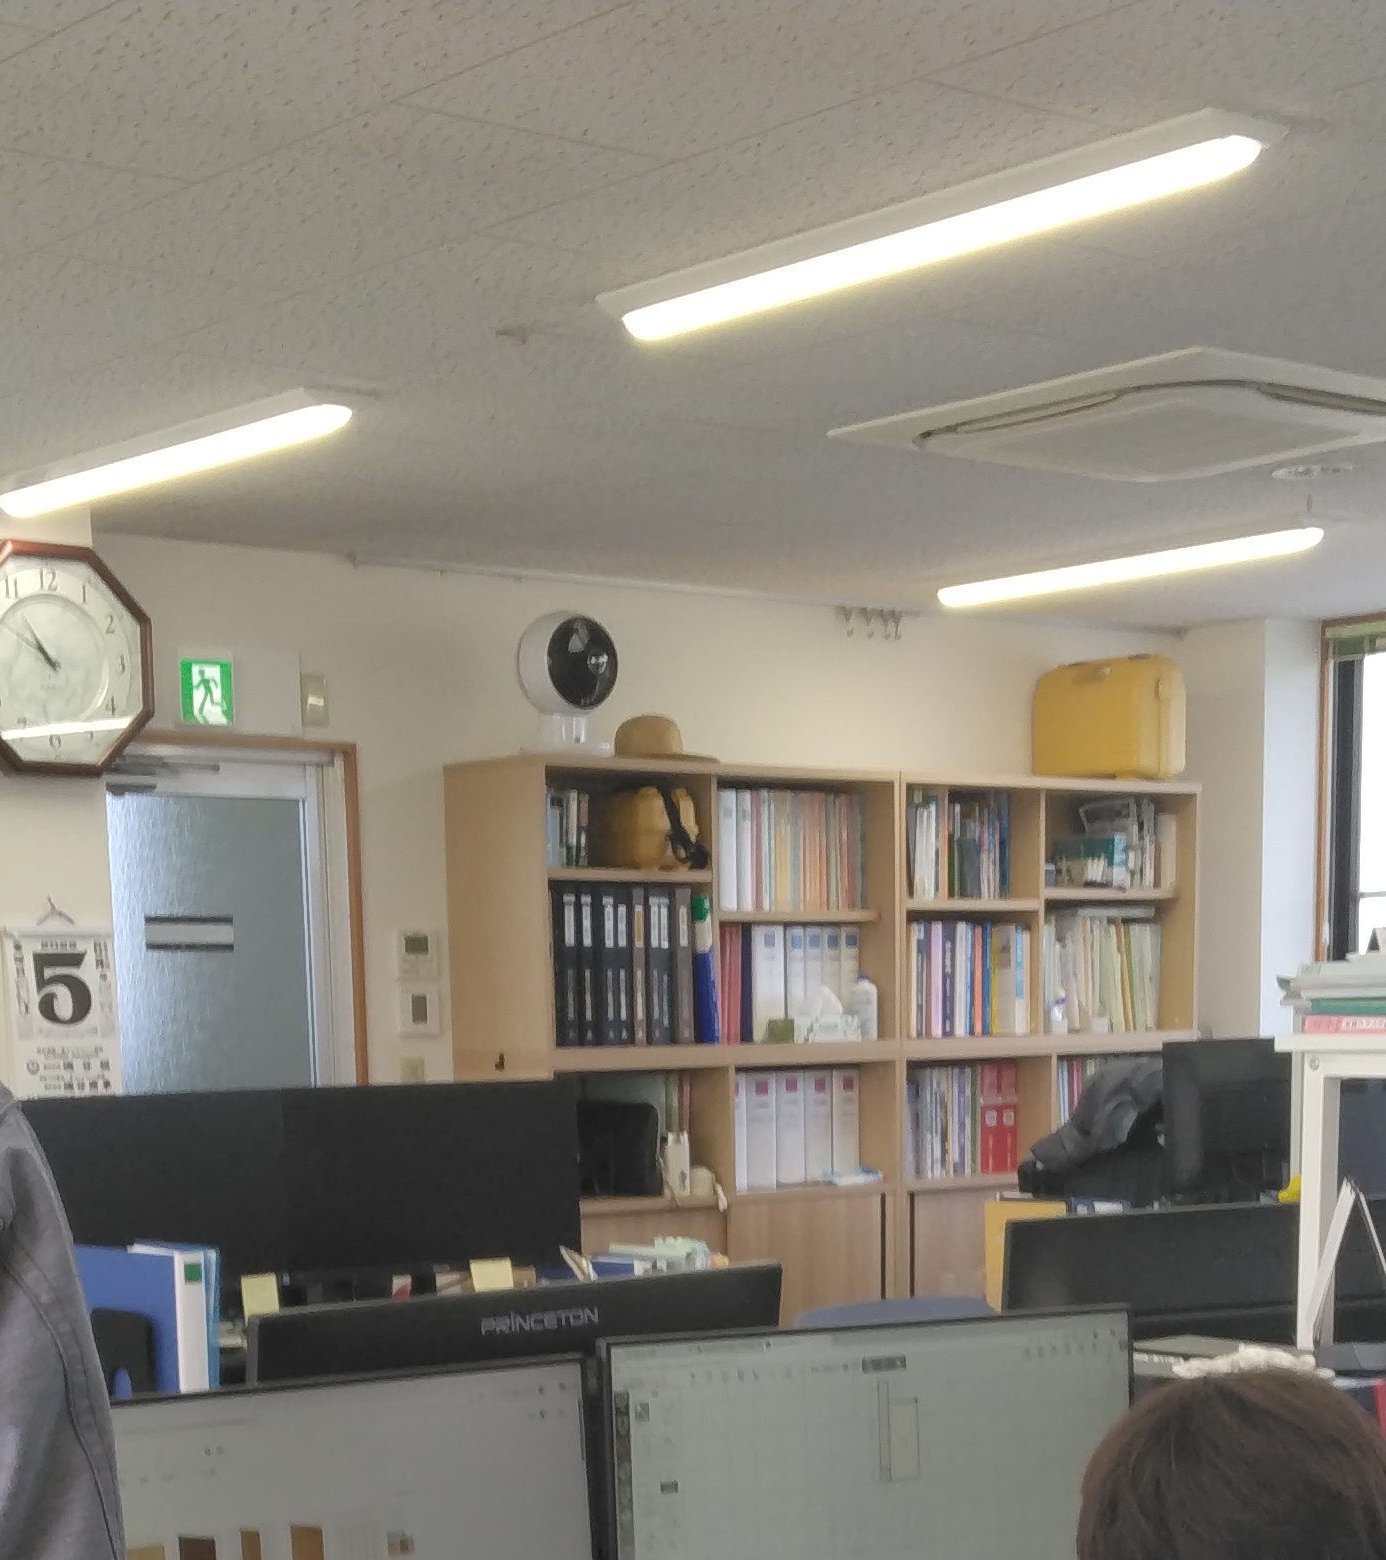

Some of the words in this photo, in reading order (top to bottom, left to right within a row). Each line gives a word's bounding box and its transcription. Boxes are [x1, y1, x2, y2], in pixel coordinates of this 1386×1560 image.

[4, 577, 19, 598] 11
[39, 569, 58, 592] 12
[80, 583, 87, 603] 1
[105, 613, 116, 634] 2
[116, 654, 126, 676] 3
[105, 695, 116, 717] 4
[33, 952, 92, 1026] 5
[480, 1306, 599, 1337] PRINCETON
